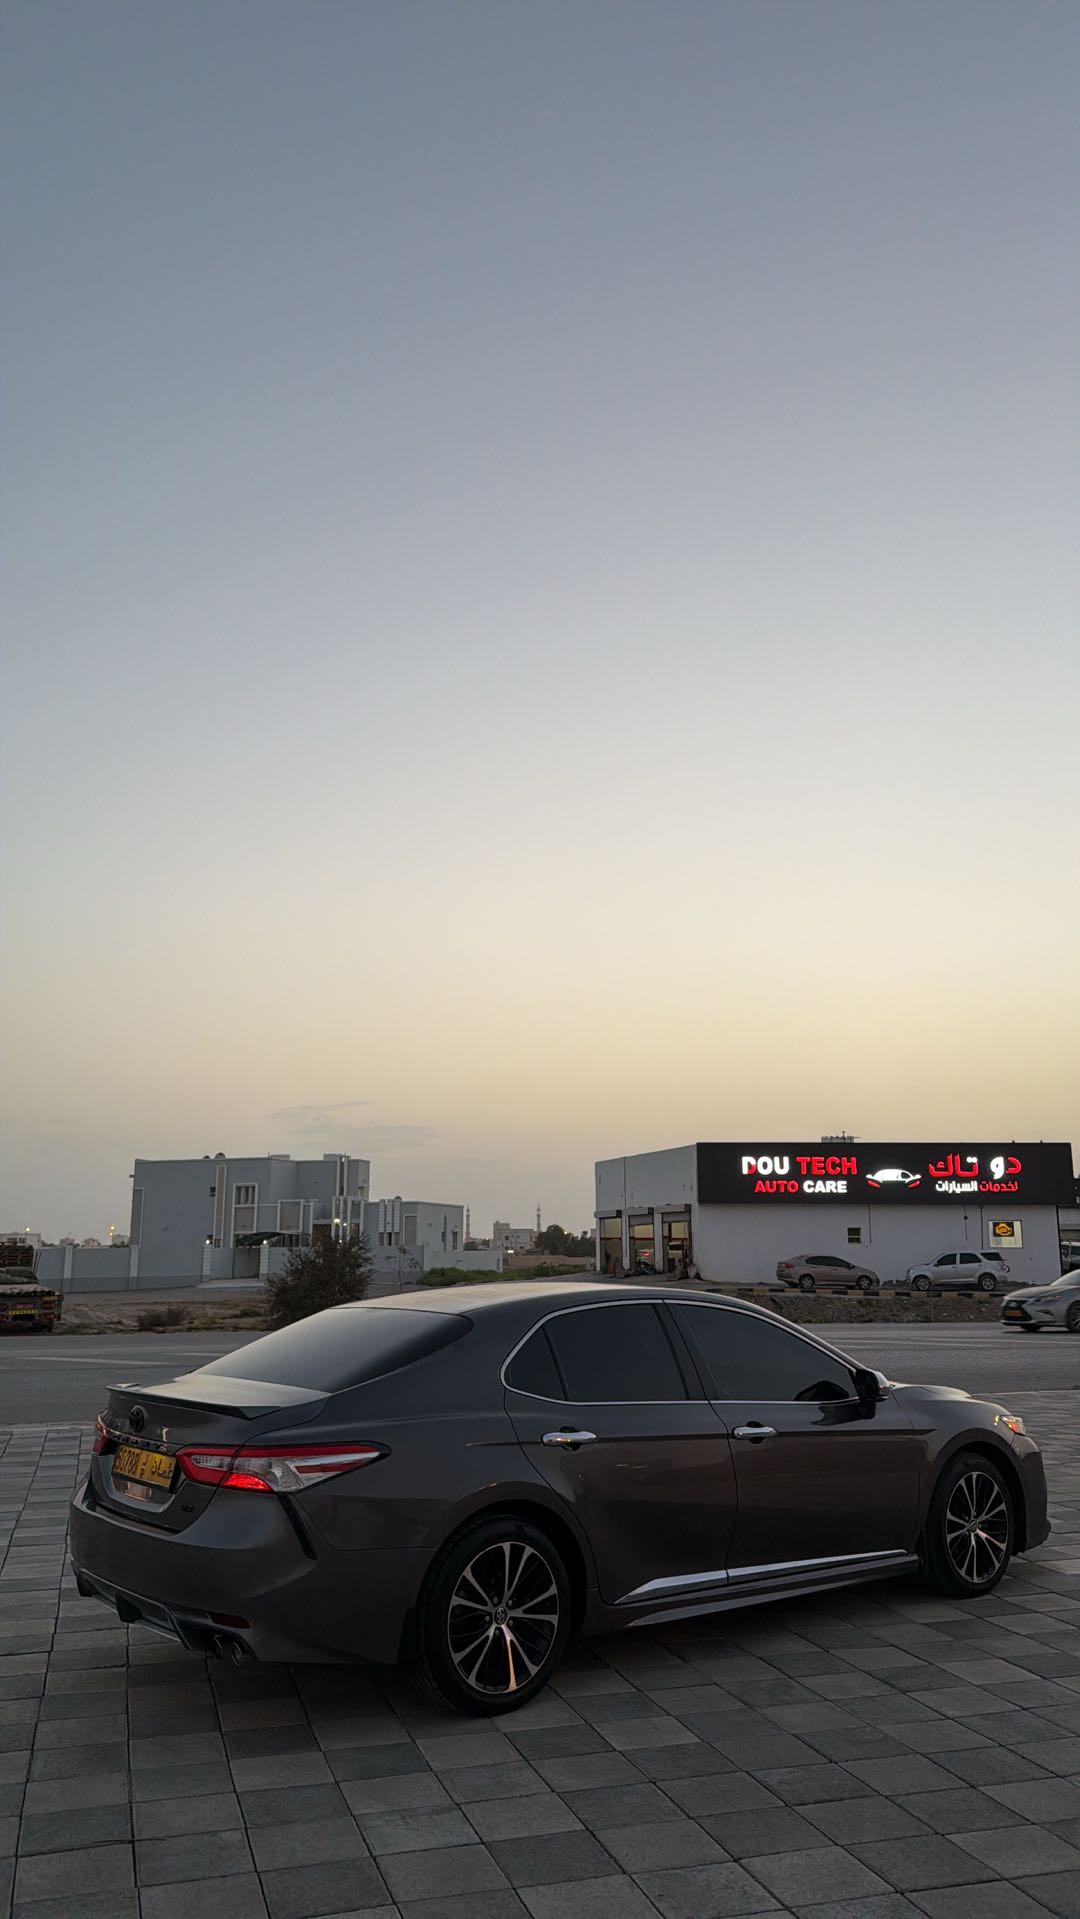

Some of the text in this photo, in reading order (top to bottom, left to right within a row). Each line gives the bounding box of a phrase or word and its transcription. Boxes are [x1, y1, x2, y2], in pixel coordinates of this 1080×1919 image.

[741, 1155, 858, 1176] DOU TECH
[928, 1153, 1022, 1179] دو تاك
[754, 1180, 848, 1194] AUTO CARE
[935, 1180, 1019, 1194] لخدمات السيارات
